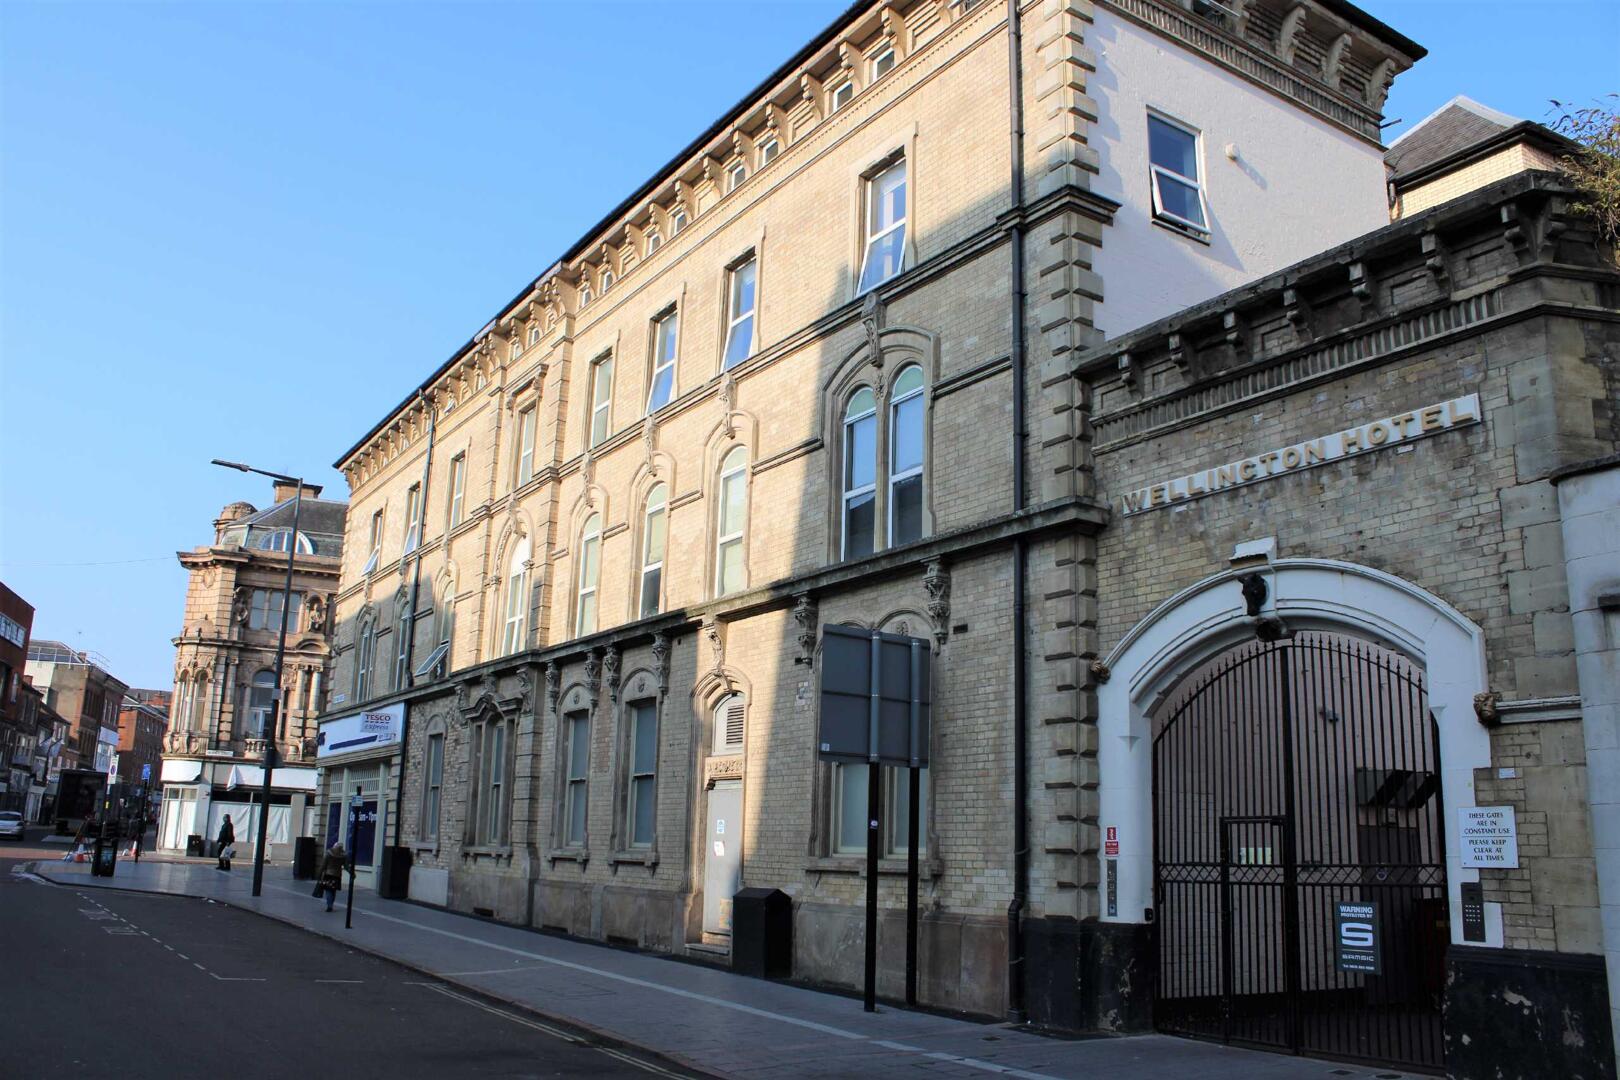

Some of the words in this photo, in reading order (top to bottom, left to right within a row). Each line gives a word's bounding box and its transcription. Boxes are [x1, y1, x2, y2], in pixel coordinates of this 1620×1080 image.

[1123, 439, 1326, 513] WELLINGTON
[1341, 400, 1476, 455] HOTEL
[365, 713, 391, 721] TESCO
[1339, 905, 1373, 914] WARNING
